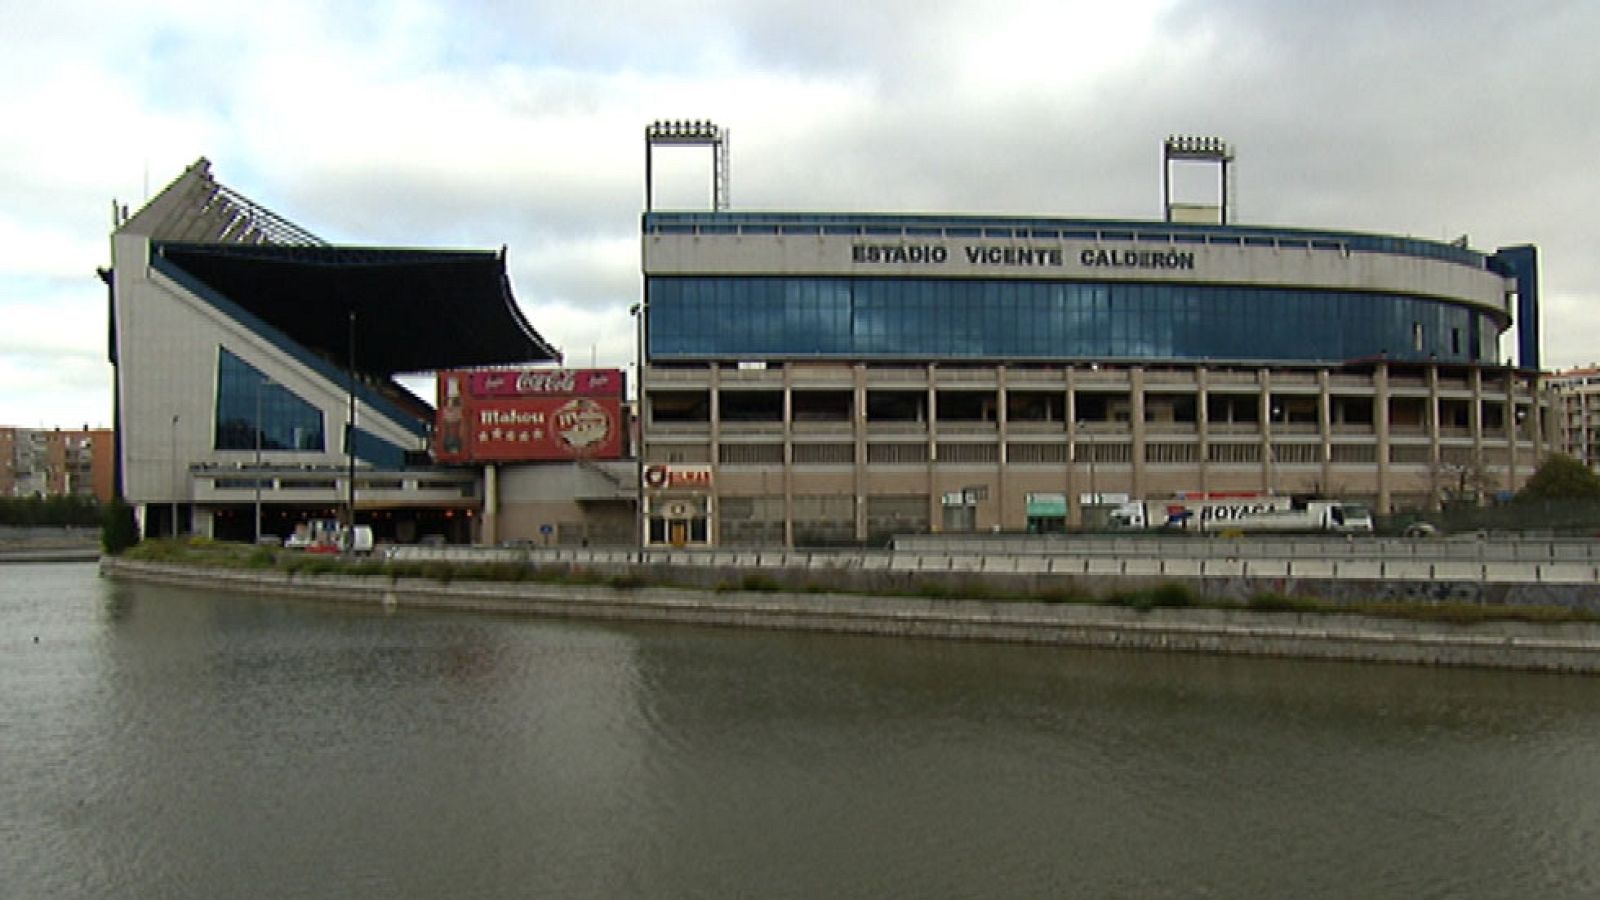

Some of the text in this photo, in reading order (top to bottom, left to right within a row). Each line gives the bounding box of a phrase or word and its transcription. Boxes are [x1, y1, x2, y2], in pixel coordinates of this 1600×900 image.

[852, 245, 1195, 270] ESTADIO VICENTE CALDERÓN
[480, 409, 545, 425] Mahou
